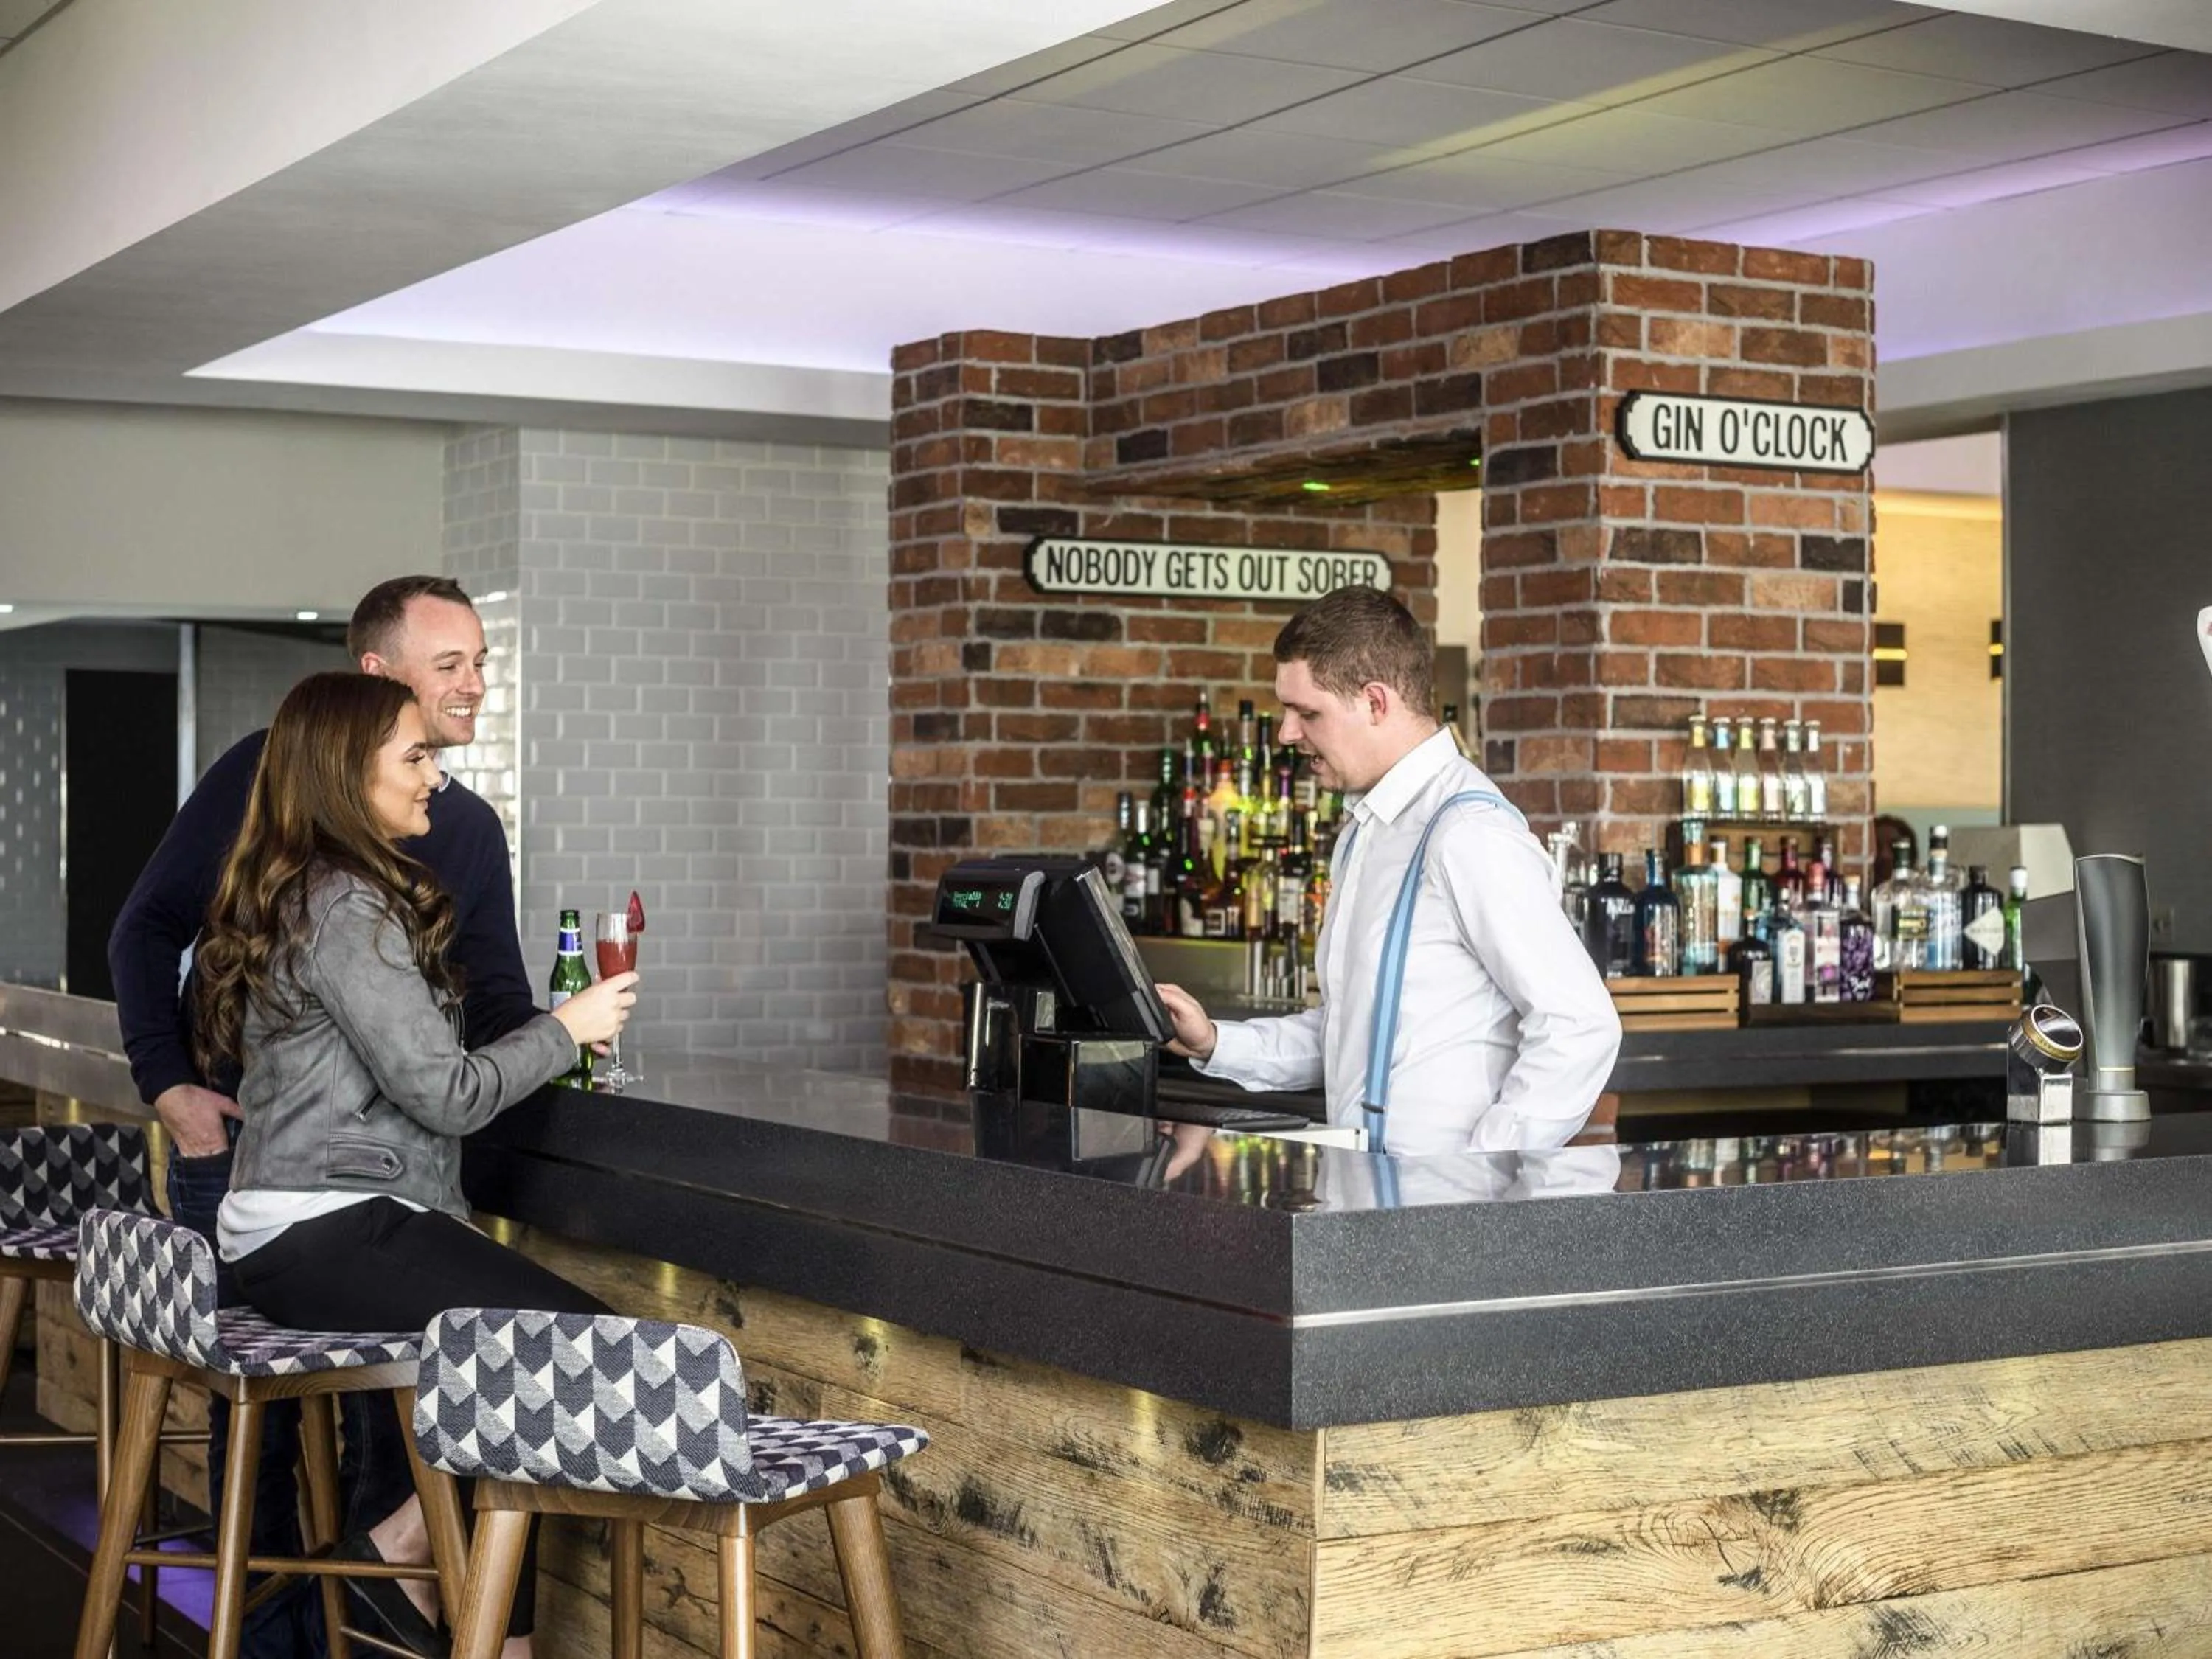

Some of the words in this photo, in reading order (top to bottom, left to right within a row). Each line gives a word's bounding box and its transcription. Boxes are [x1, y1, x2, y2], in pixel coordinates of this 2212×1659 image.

[1652, 404, 1703, 451] GIN
[1720, 408, 1847, 462] O'CLOCK
[1046, 546, 1157, 587] NOBODY
[1166, 551, 1229, 589] GETS
[1239, 554, 1290, 592] OUT
[1298, 558, 1377, 593] SOBER
